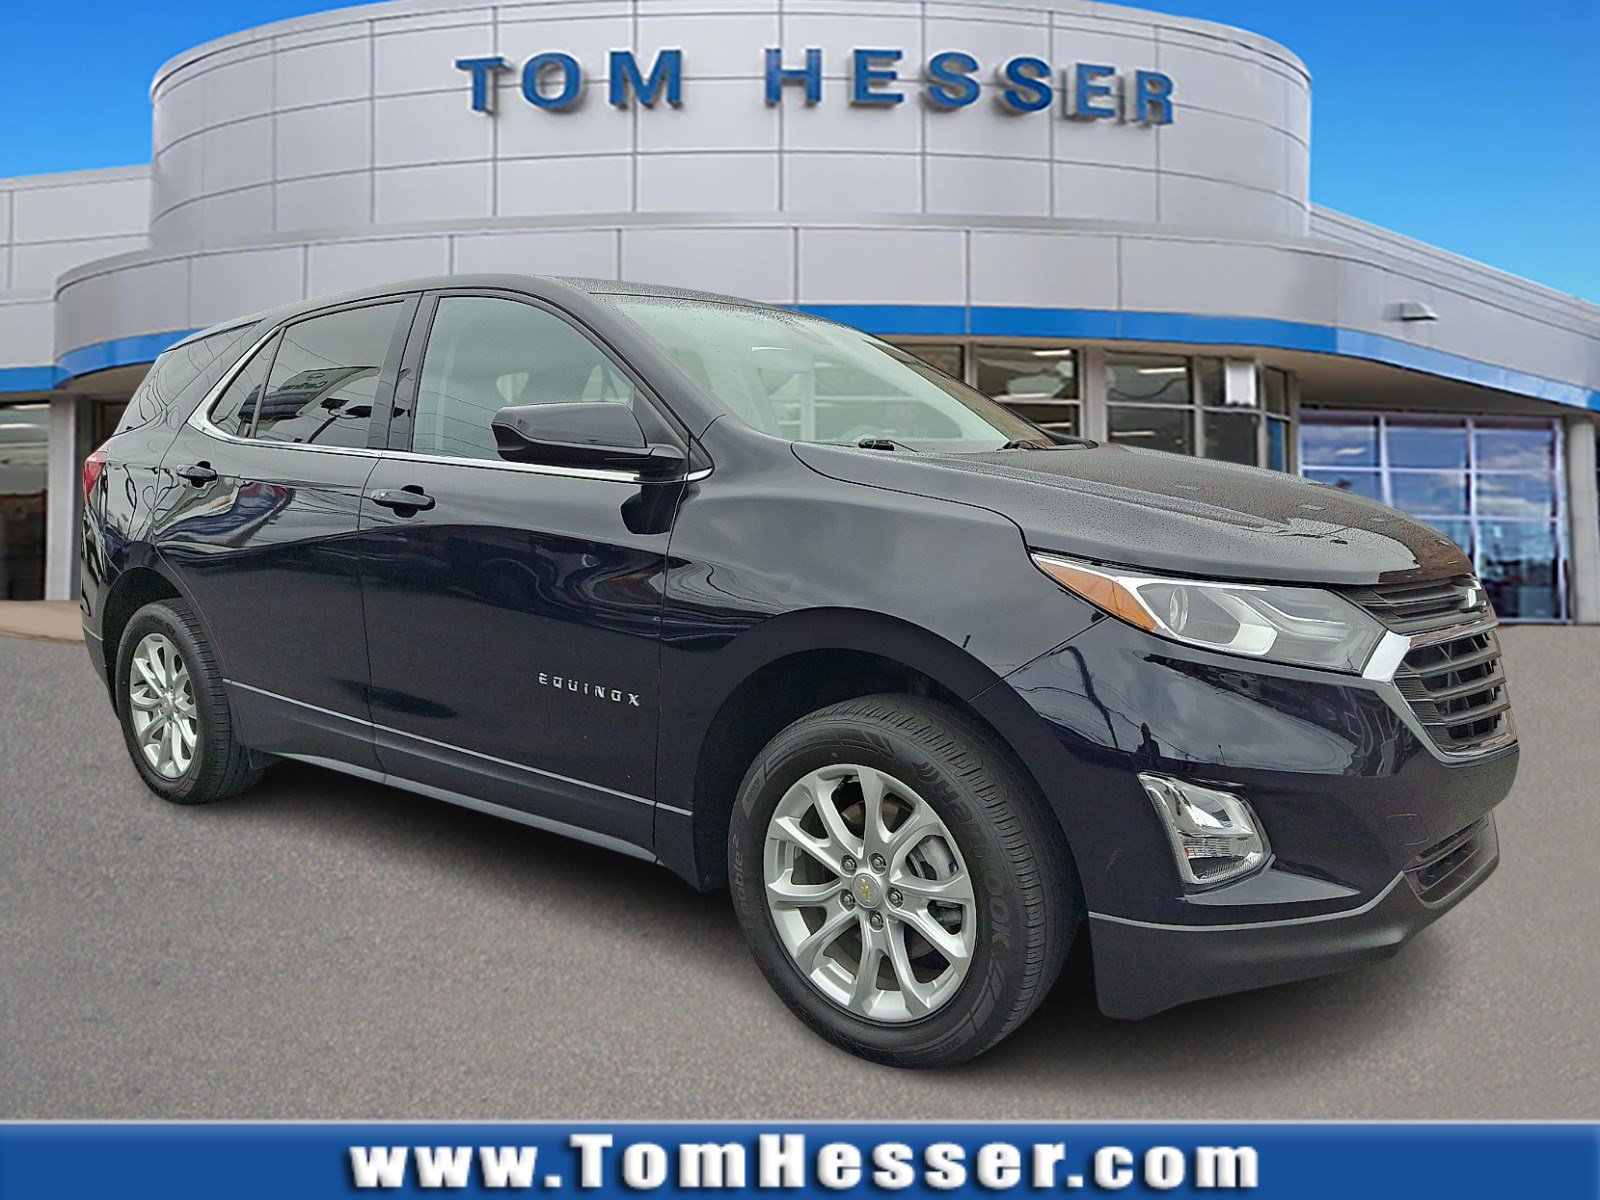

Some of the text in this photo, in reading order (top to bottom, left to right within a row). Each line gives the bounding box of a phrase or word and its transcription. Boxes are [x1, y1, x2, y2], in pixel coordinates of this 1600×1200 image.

[456, 48, 1176, 125] TOM HESSER
[538, 672, 640, 707] EQUINOX
